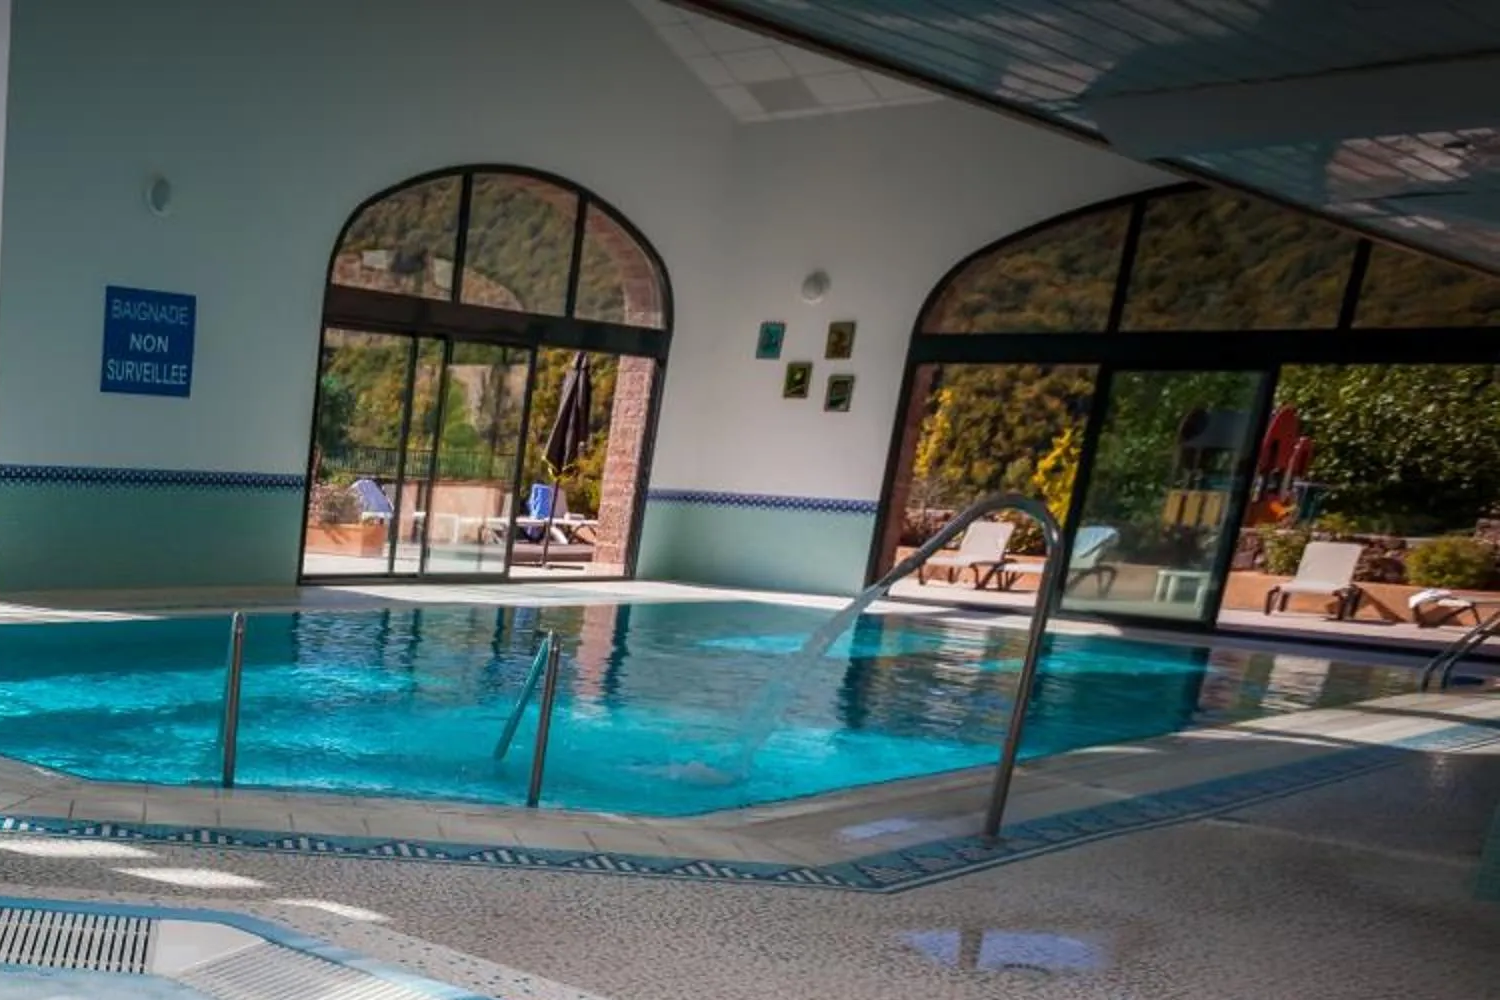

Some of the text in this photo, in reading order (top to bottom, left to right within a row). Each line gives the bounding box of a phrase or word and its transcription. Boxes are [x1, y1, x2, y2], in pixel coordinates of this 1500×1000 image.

[112, 298, 189, 325] BAIGNADE
[129, 333, 169, 353] NON
[107, 358, 188, 385] SURVEILLEE
